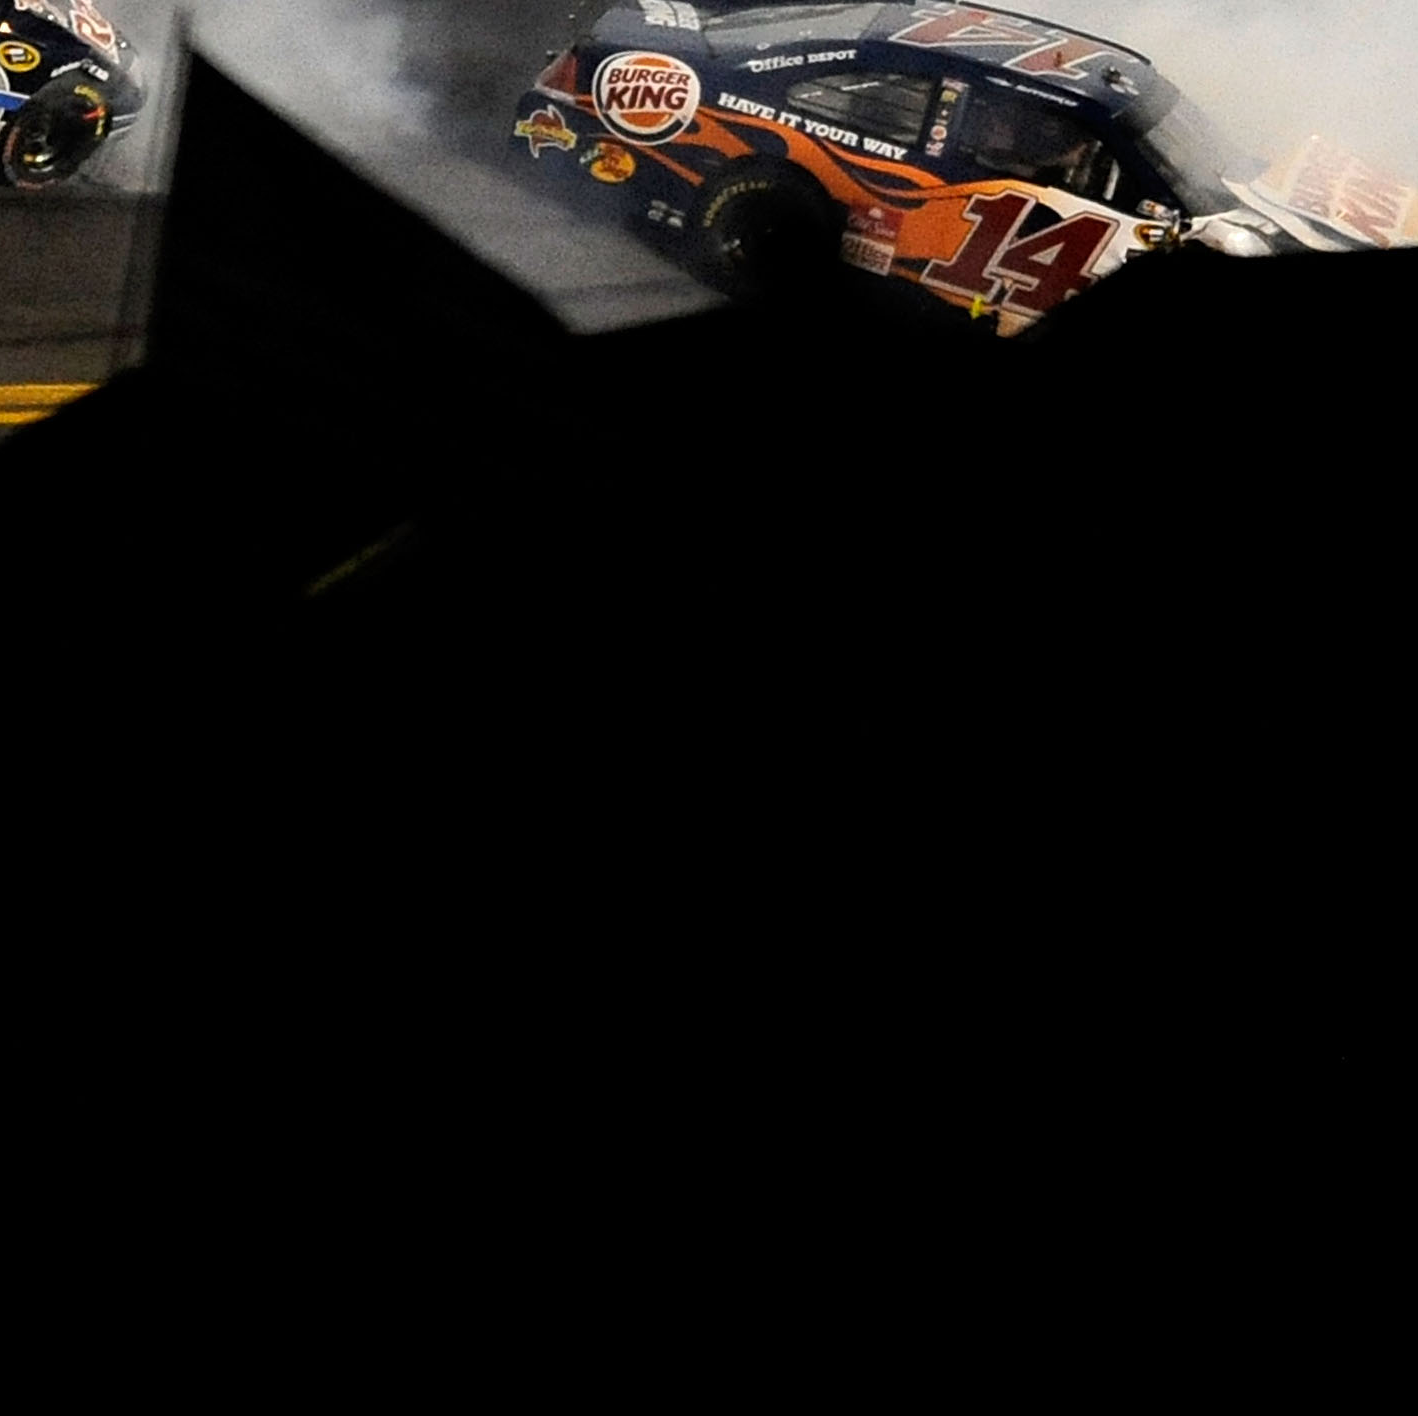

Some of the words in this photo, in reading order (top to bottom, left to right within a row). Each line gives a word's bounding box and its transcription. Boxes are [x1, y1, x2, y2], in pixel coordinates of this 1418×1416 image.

[746, 53, 804, 74] Office
[806, 49, 857, 66] DEPOT
[607, 66, 692, 88] BURGER
[603, 85, 689, 114] KING
[717, 92, 776, 123] HAVE
[777, 110, 802, 129] IT
[804, 119, 861, 148] YOUR
[861, 135, 909, 162] WAY
[918, 187, 1122, 318] 14
